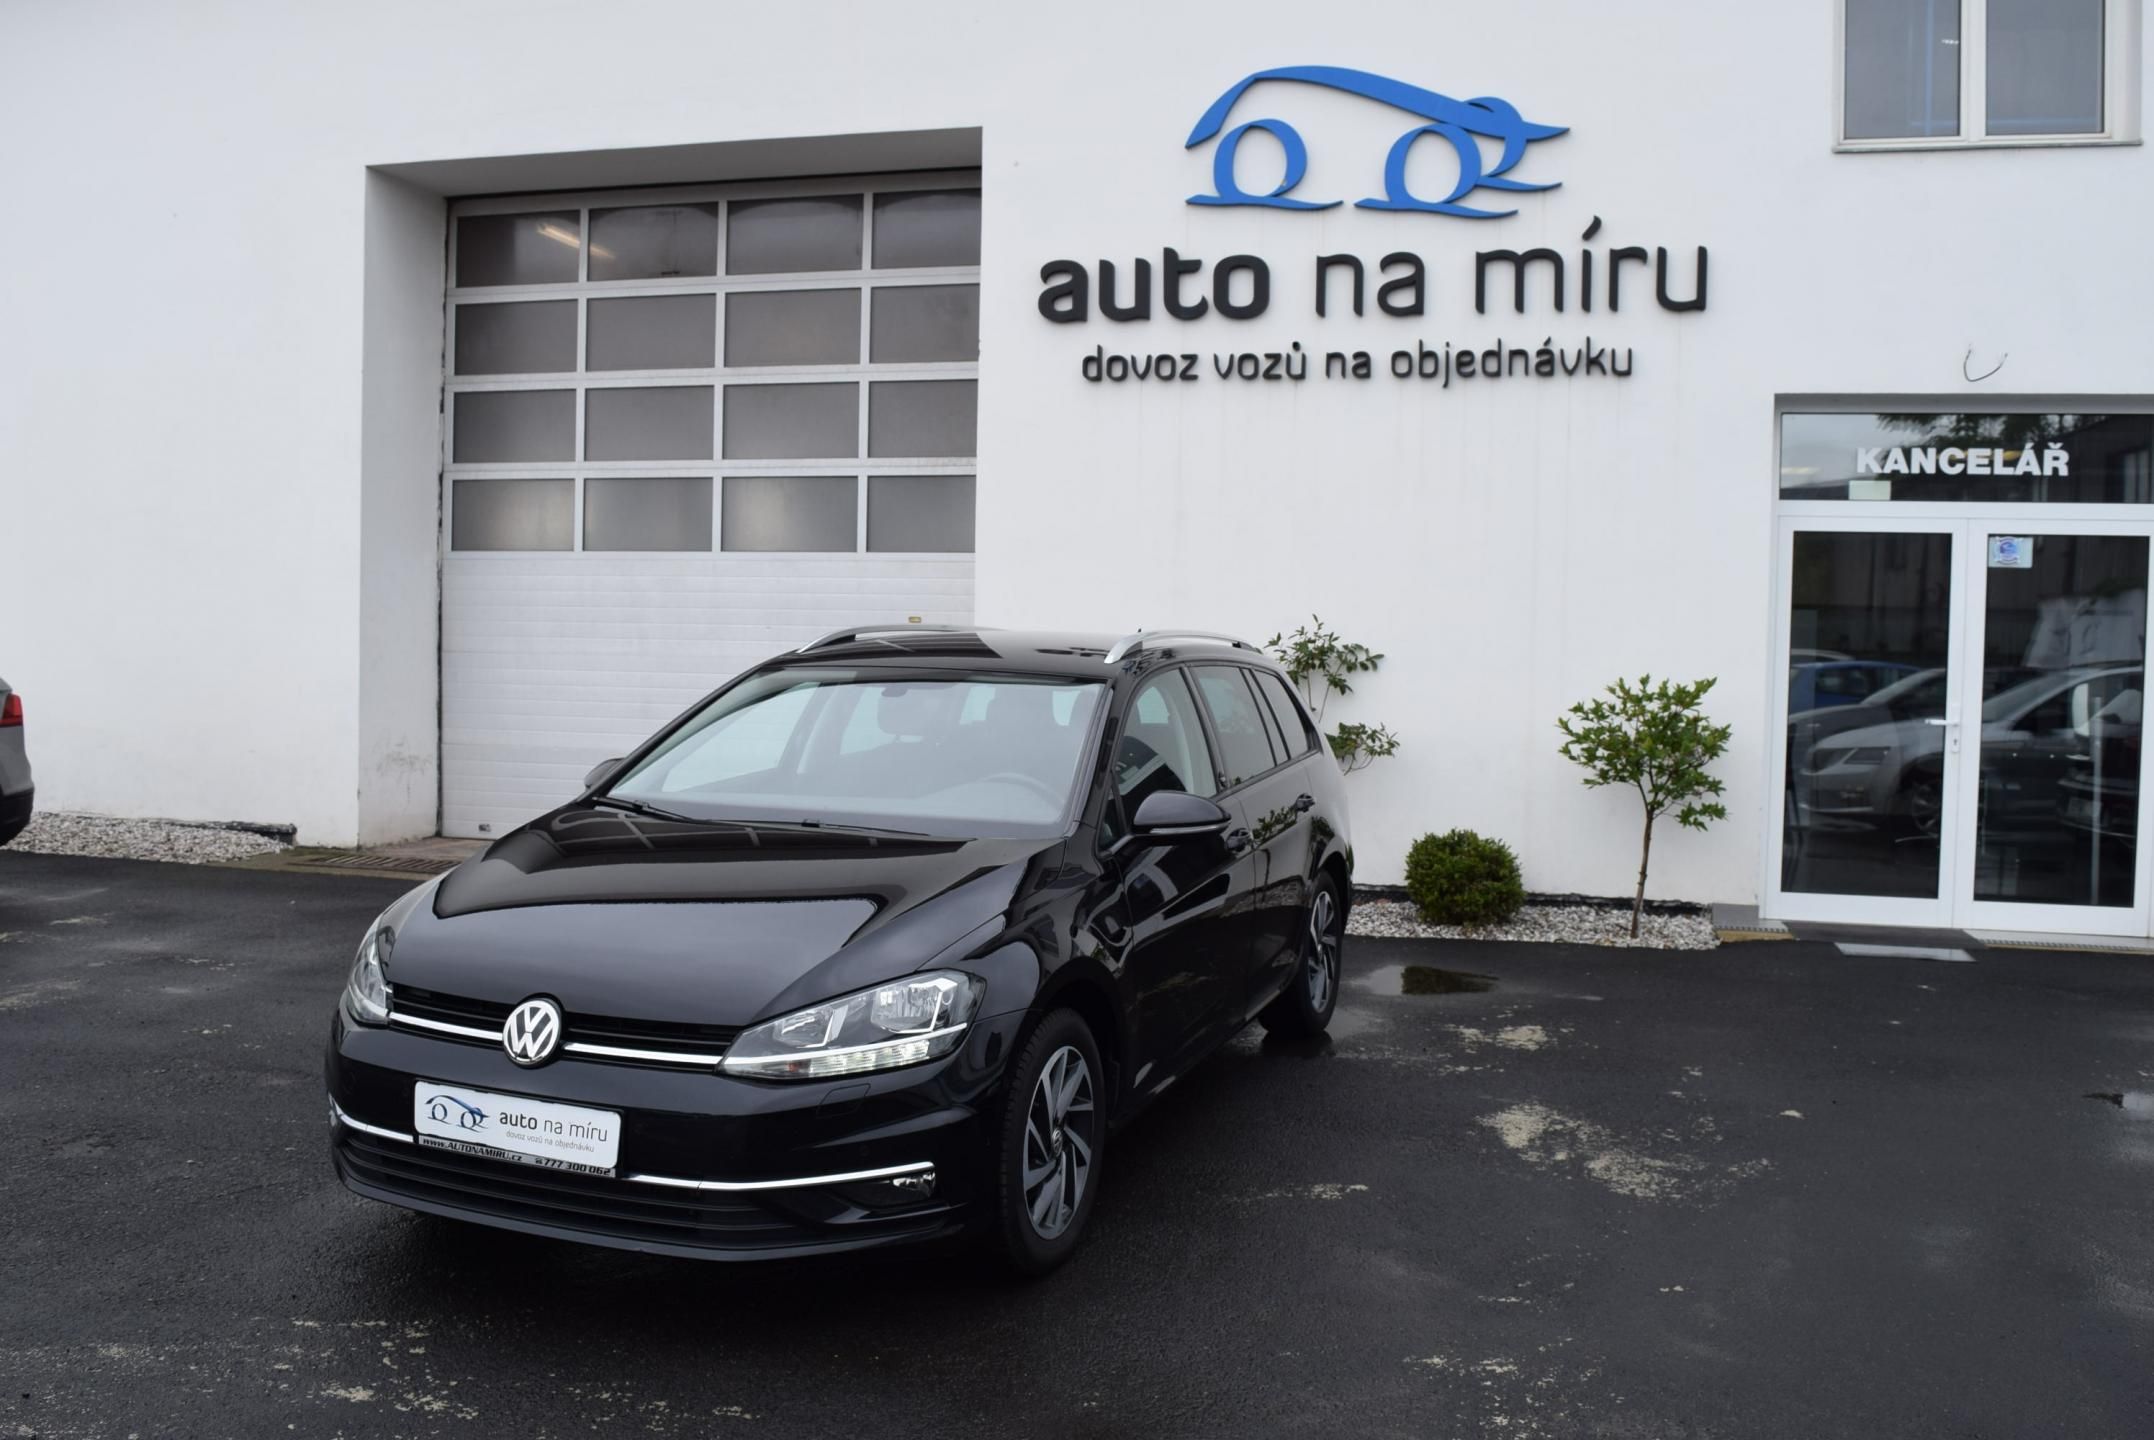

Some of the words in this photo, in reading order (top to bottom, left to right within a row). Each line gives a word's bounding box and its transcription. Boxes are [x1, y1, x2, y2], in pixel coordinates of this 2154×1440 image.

[1037, 247, 1271, 325] auto
[1315, 251, 1426, 319] na
[1474, 214, 1708, 315] míru
[1082, 344, 1199, 384] dovoz
[1212, 341, 1308, 383] vozů
[1325, 350, 1372, 381] na
[1390, 335, 1634, 389] objednávku
[1856, 443, 2070, 477] KANCELÁŘ
[499, 1111, 538, 1131] auto
[543, 1119, 563, 1135] na
[569, 1121, 608, 1142] míru
[505, 1129, 526, 1141] dovoz
[544, 1137, 553, 1146] na
[554, 1138, 595, 1153] objednávku
[423, 1138, 523, 1162] www.AUTONAMIRU.cz
[544, 1158, 564, 1169] 777
[565, 1161, 587, 1173] 300
[588, 1165, 612, 1177] 062
